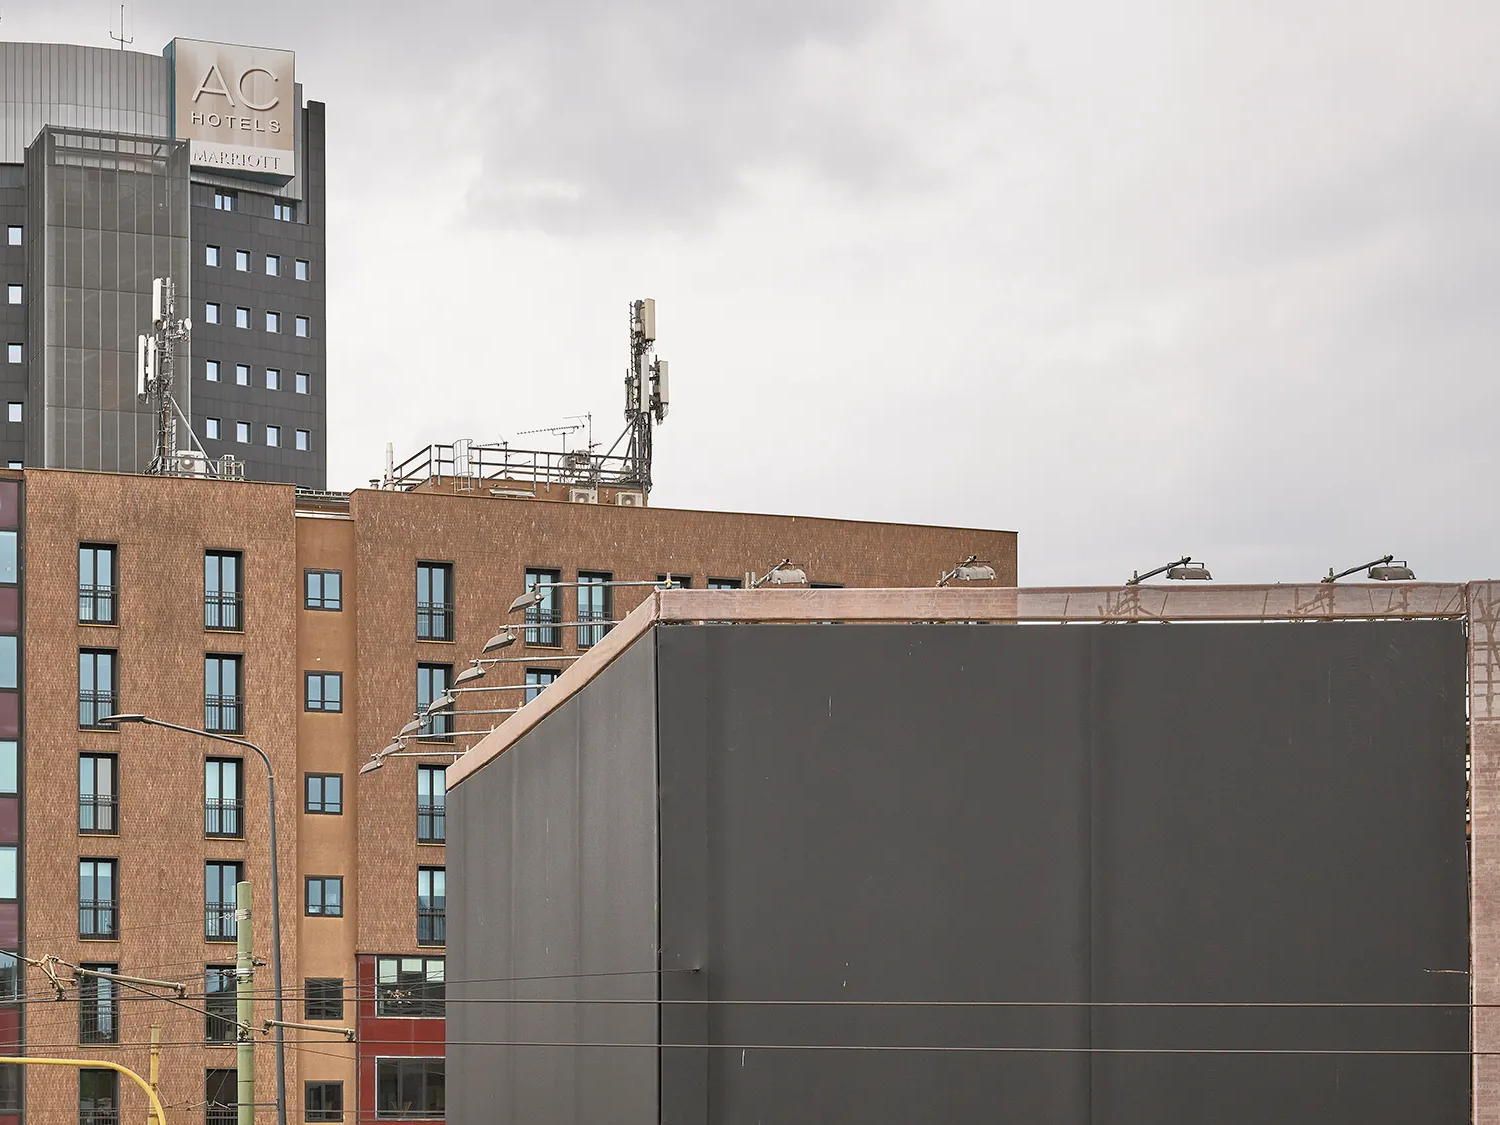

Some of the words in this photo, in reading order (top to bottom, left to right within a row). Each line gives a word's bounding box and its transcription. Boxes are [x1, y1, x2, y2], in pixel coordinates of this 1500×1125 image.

[192, 64, 279, 111] AC
[191, 111, 281, 134] HOTELS
[194, 149, 281, 170] MARRIOTT
